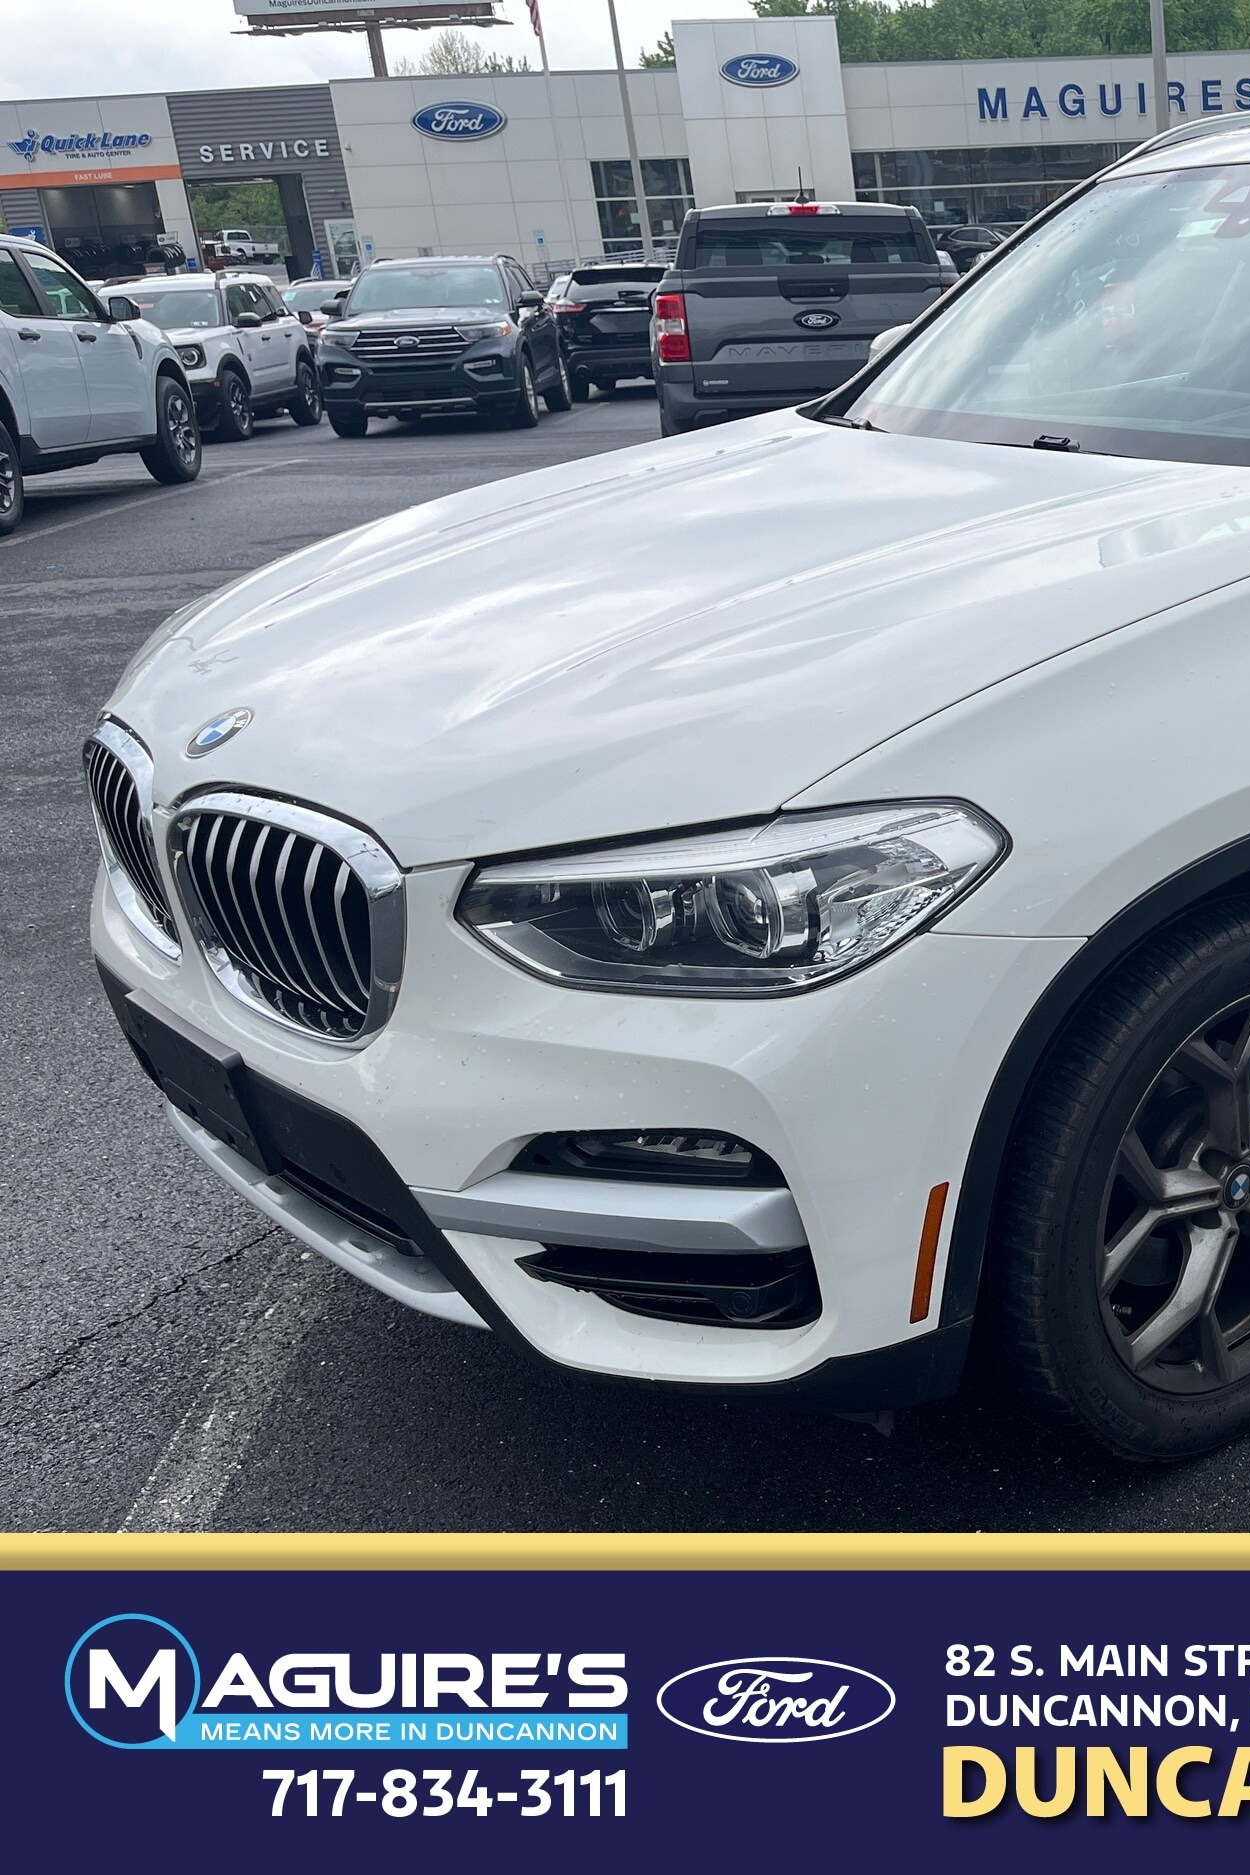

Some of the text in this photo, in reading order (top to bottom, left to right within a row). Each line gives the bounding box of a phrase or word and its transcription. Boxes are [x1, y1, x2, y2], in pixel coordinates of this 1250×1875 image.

[736, 59, 782, 81] Ford
[430, 108, 485, 132] Ford
[40, 132, 151, 153] Quick Lane
[199, 139, 329, 163] SERVICE
[87, 151, 105, 159] AUTO
[74, 172, 113, 181] FAST LUBE
[728, 342, 862, 359] MAVERI
